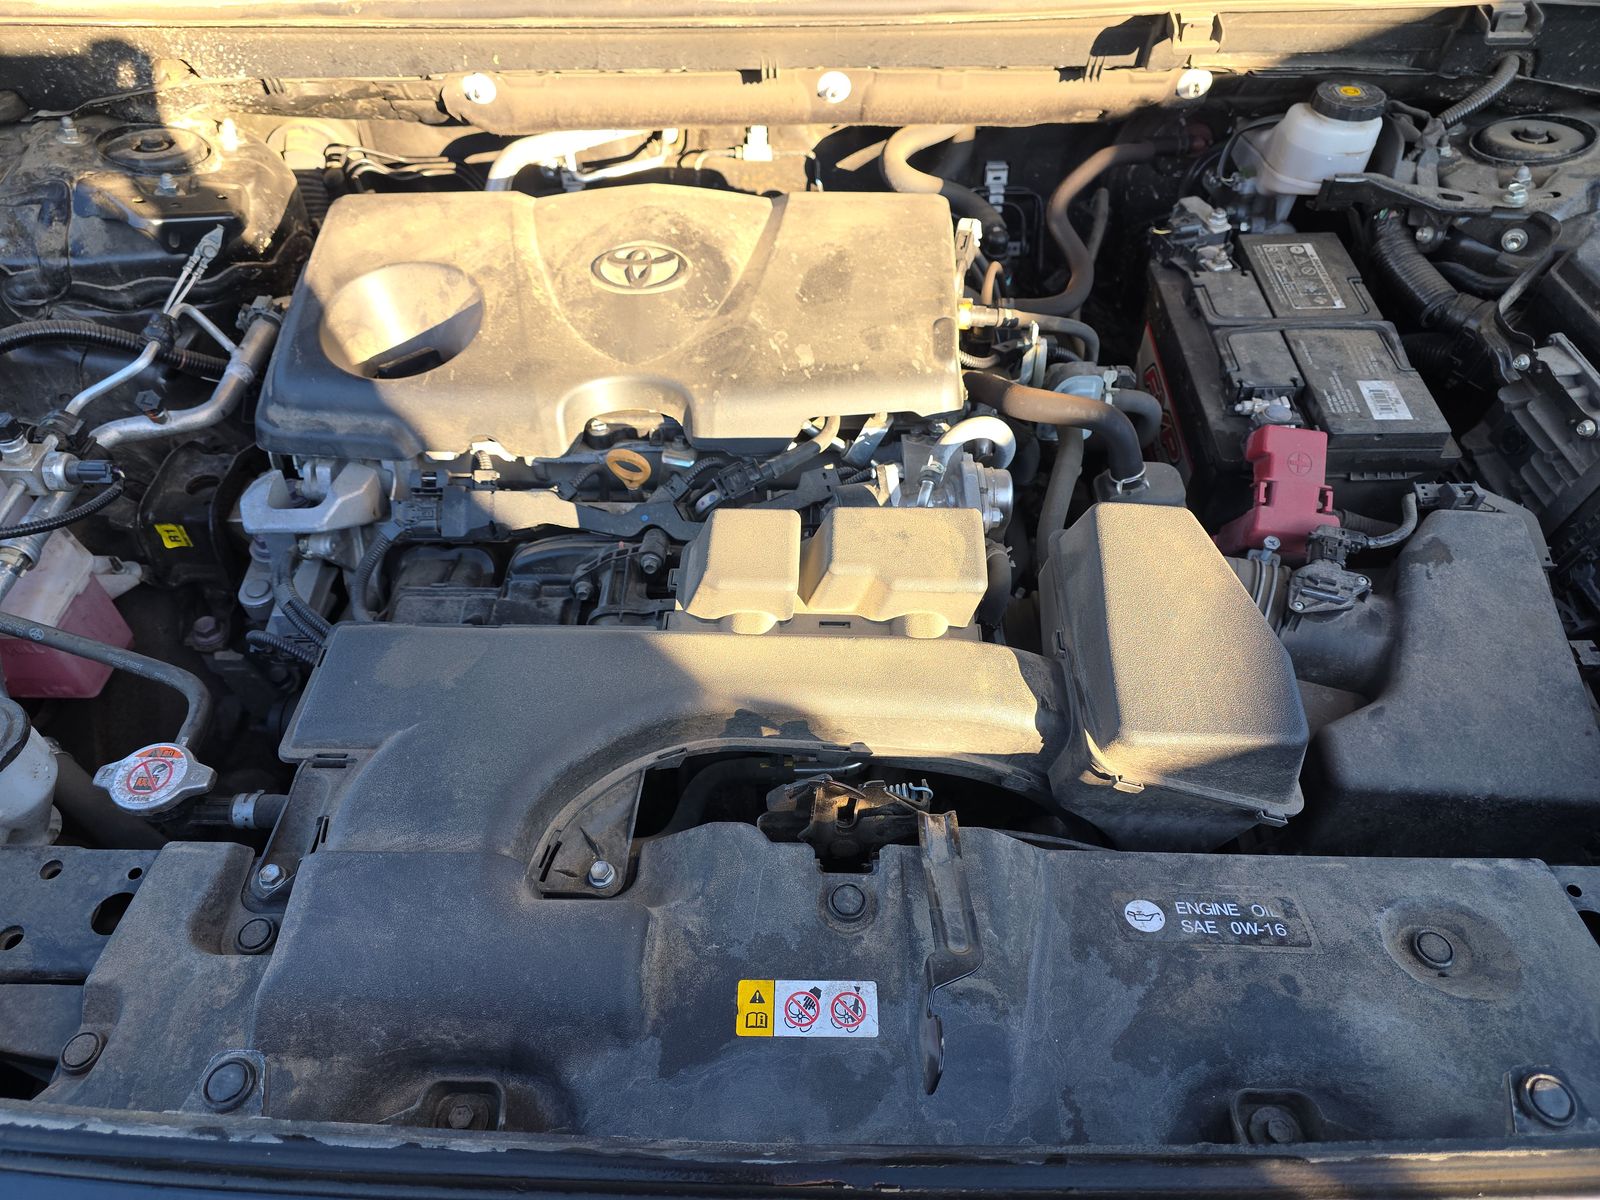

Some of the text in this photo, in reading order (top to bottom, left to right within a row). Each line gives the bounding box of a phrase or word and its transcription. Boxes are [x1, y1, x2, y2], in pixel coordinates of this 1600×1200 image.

[1174, 901, 1281, 918] ENGINE OIL
[1181, 920, 1288, 937] SAE 0W-16
